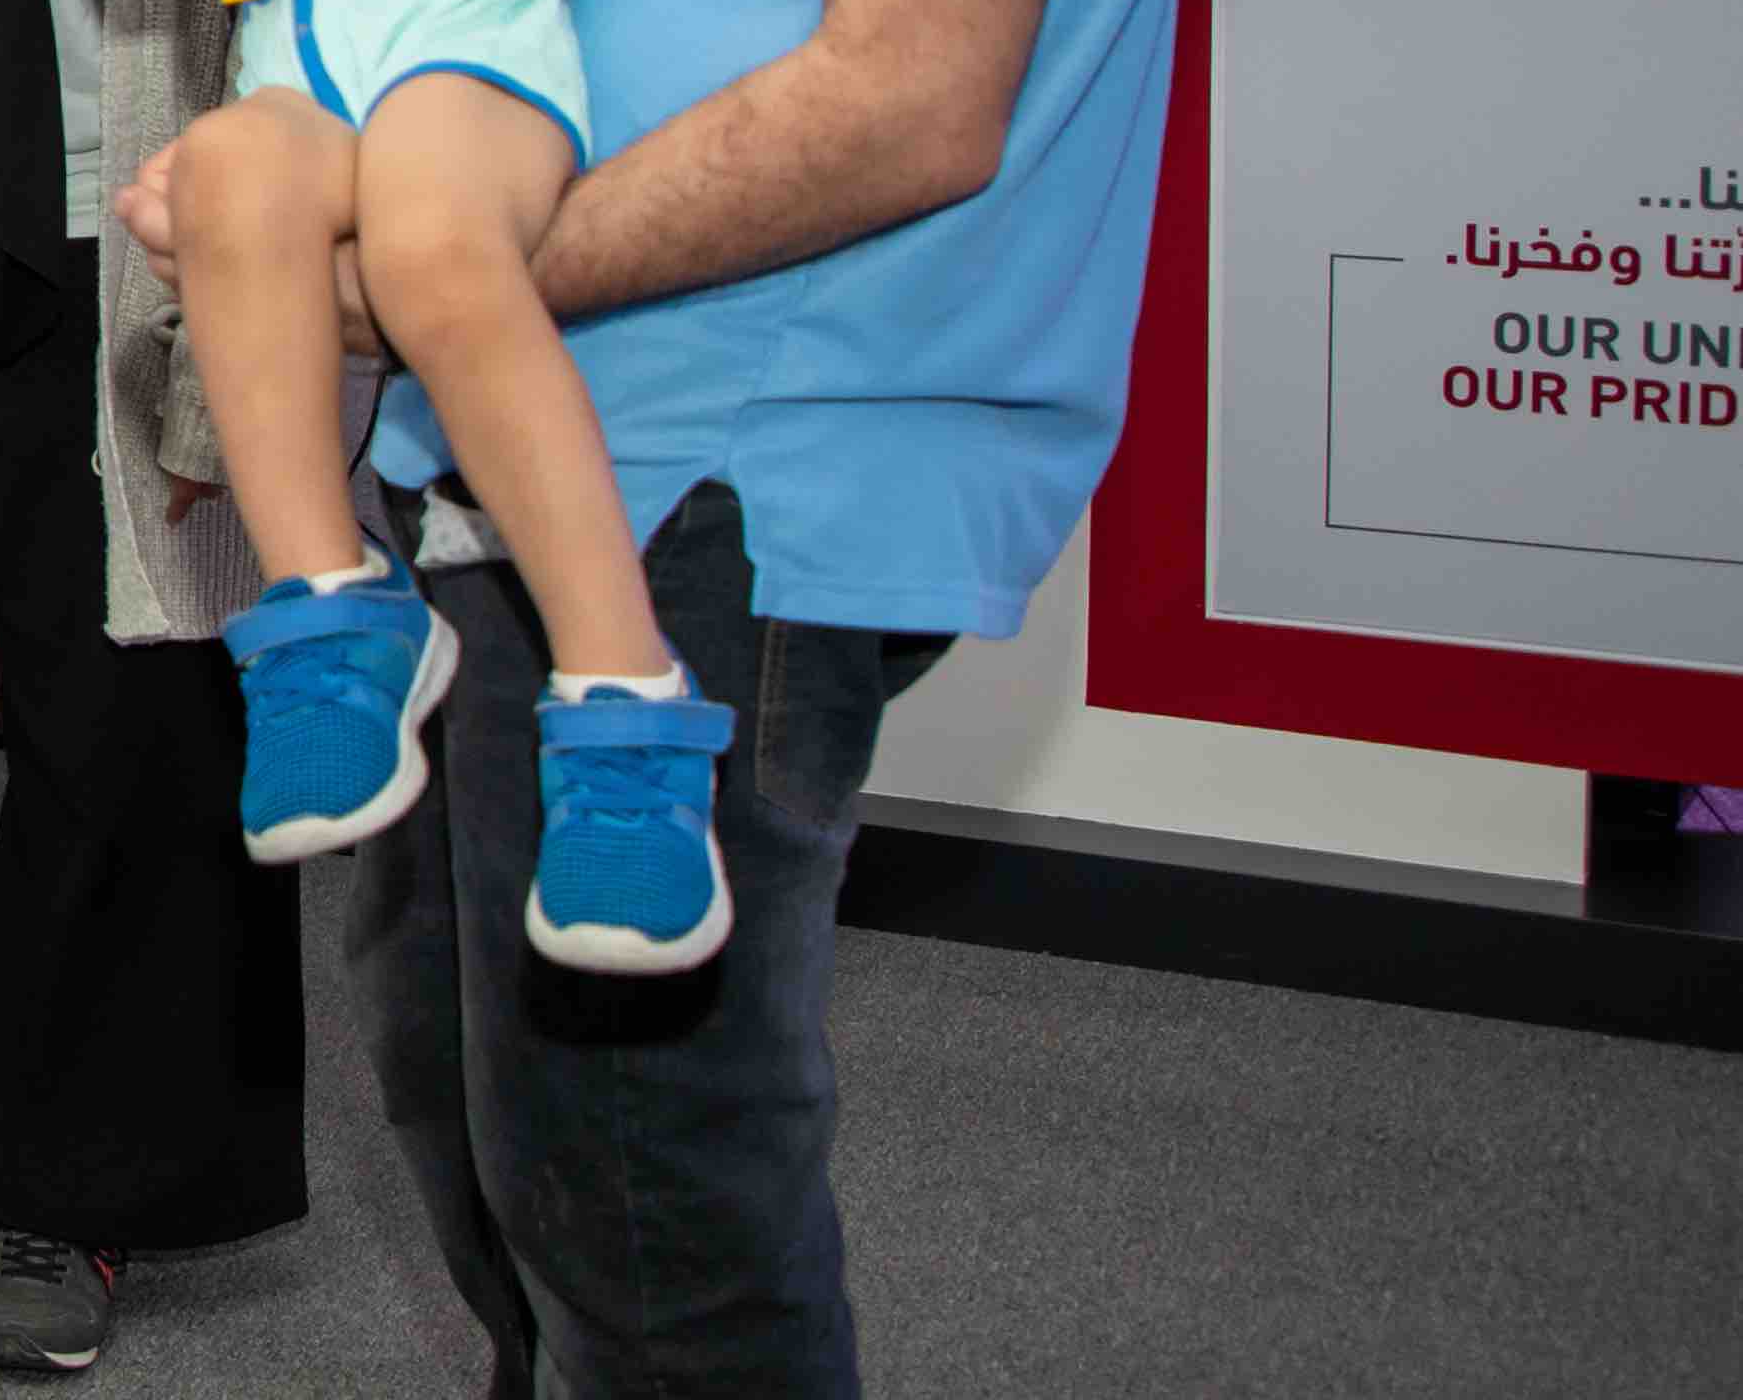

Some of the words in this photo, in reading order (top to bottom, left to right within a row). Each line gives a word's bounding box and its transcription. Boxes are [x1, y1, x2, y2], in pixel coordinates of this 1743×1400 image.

[1446, 222, 1642, 286] وفخرنا.
[1493, 311, 1620, 363] OUR
[1441, 365, 1568, 416] OUR
[1590, 375, 1739, 428] PRID
